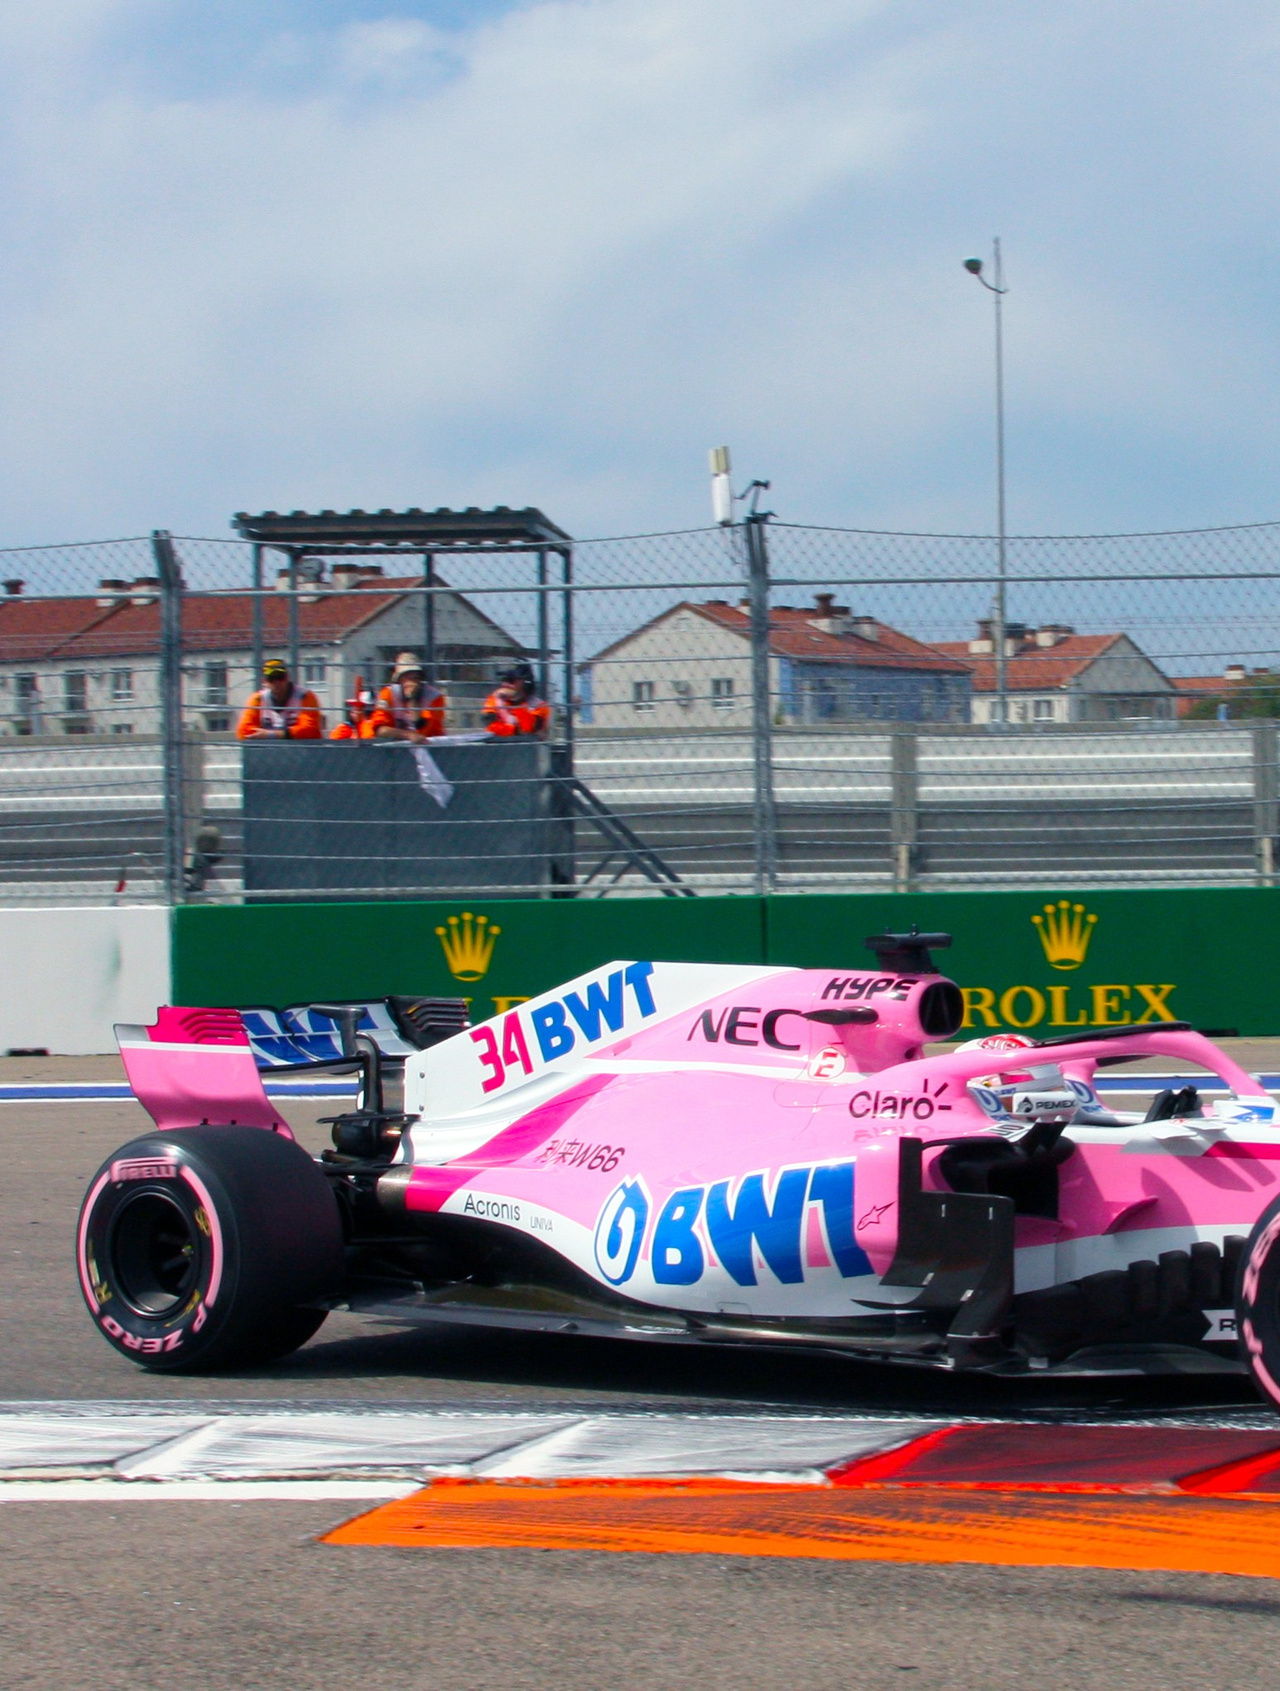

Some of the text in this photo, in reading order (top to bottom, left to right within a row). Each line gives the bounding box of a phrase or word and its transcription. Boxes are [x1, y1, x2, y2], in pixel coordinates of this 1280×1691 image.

[821, 978, 920, 1001] HYPE
[962, 985, 1177, 1027] ROLEX
[469, 1011, 534, 1094] 34
[531, 961, 657, 1063] BWT
[687, 1006, 803, 1051] NEC
[848, 1090, 934, 1120] Claro
[1035, 1100, 1076, 1110] PEMEX
[110, 1157, 178, 1184] PIRELLI
[464, 1193, 521, 1222] Acronis
[651, 1161, 875, 1287] BWT
[101, 1315, 184, 1353] ZERO
